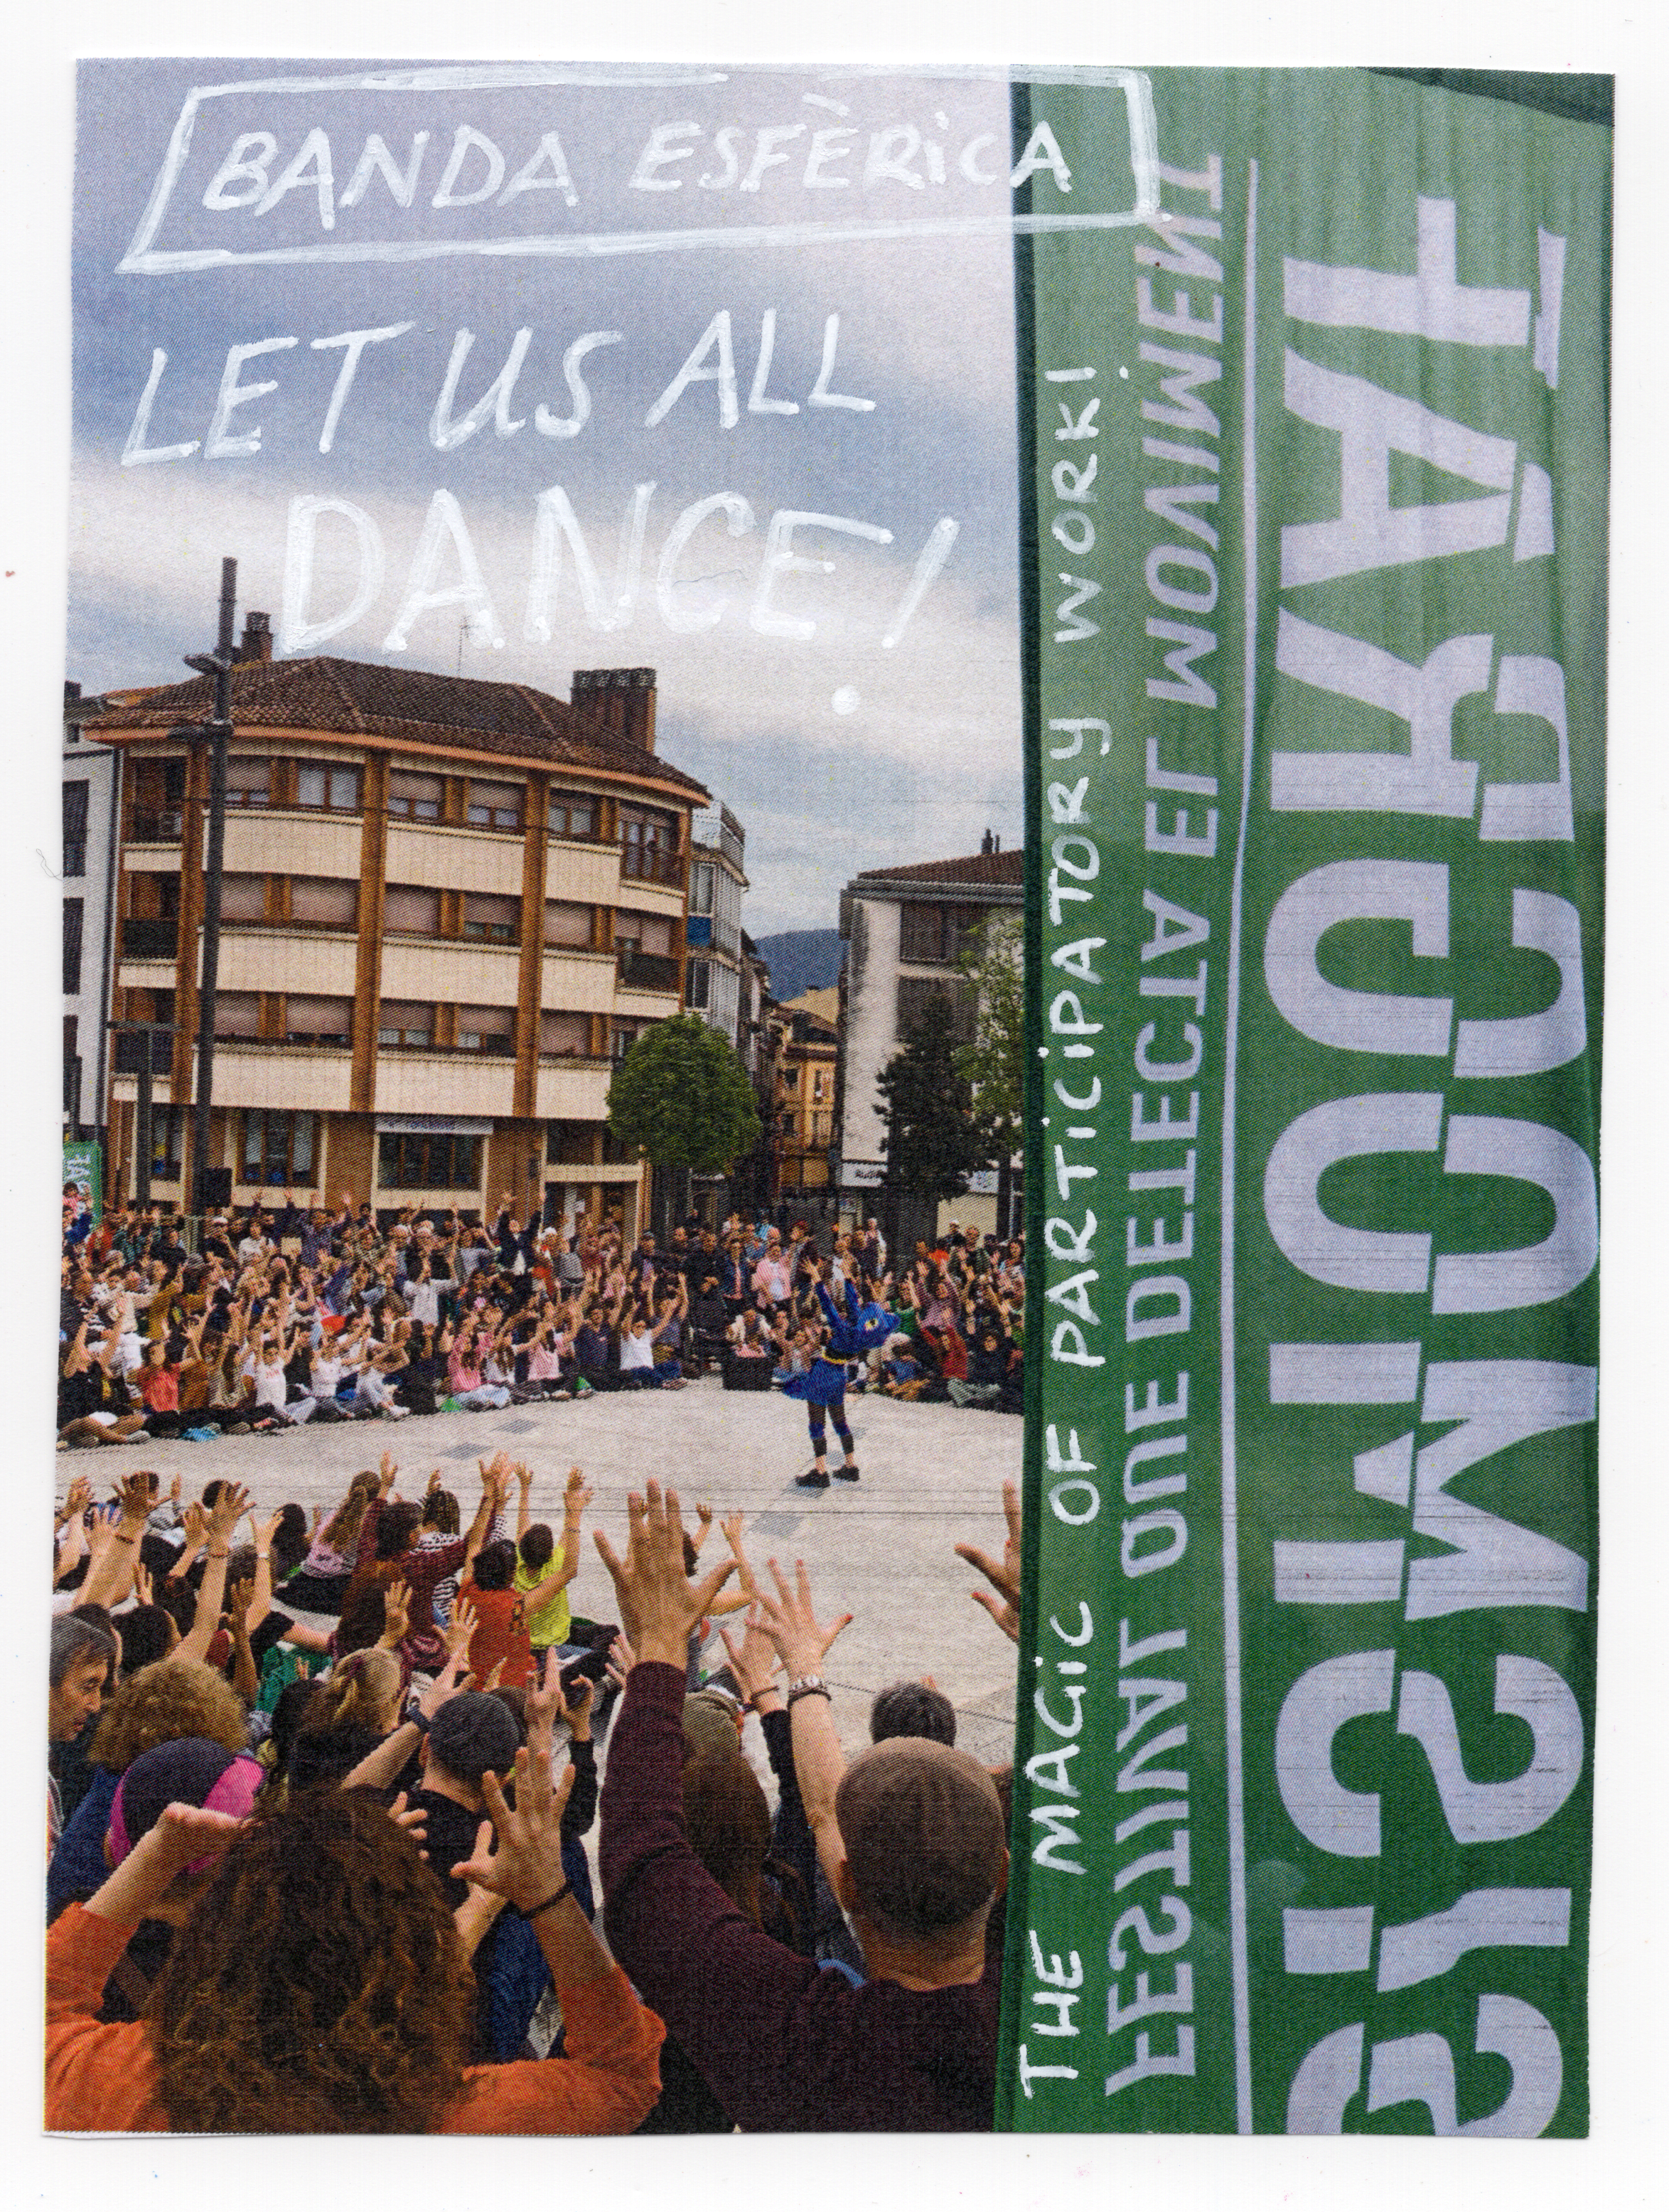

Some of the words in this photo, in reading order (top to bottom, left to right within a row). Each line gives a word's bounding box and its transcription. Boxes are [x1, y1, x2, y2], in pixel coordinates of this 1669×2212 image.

[203, 125, 579, 231] BANDA
[119, 320, 418, 467] LET
[429, 325, 624, 451] US
[644, 309, 877, 430] ALL
[1044, 365, 1129, 644] WORK!
[279, 480, 961, 717] DANCE!
[1046, 1423, 1100, 1526] OF
[1019, 1928, 1085, 2100] THE
